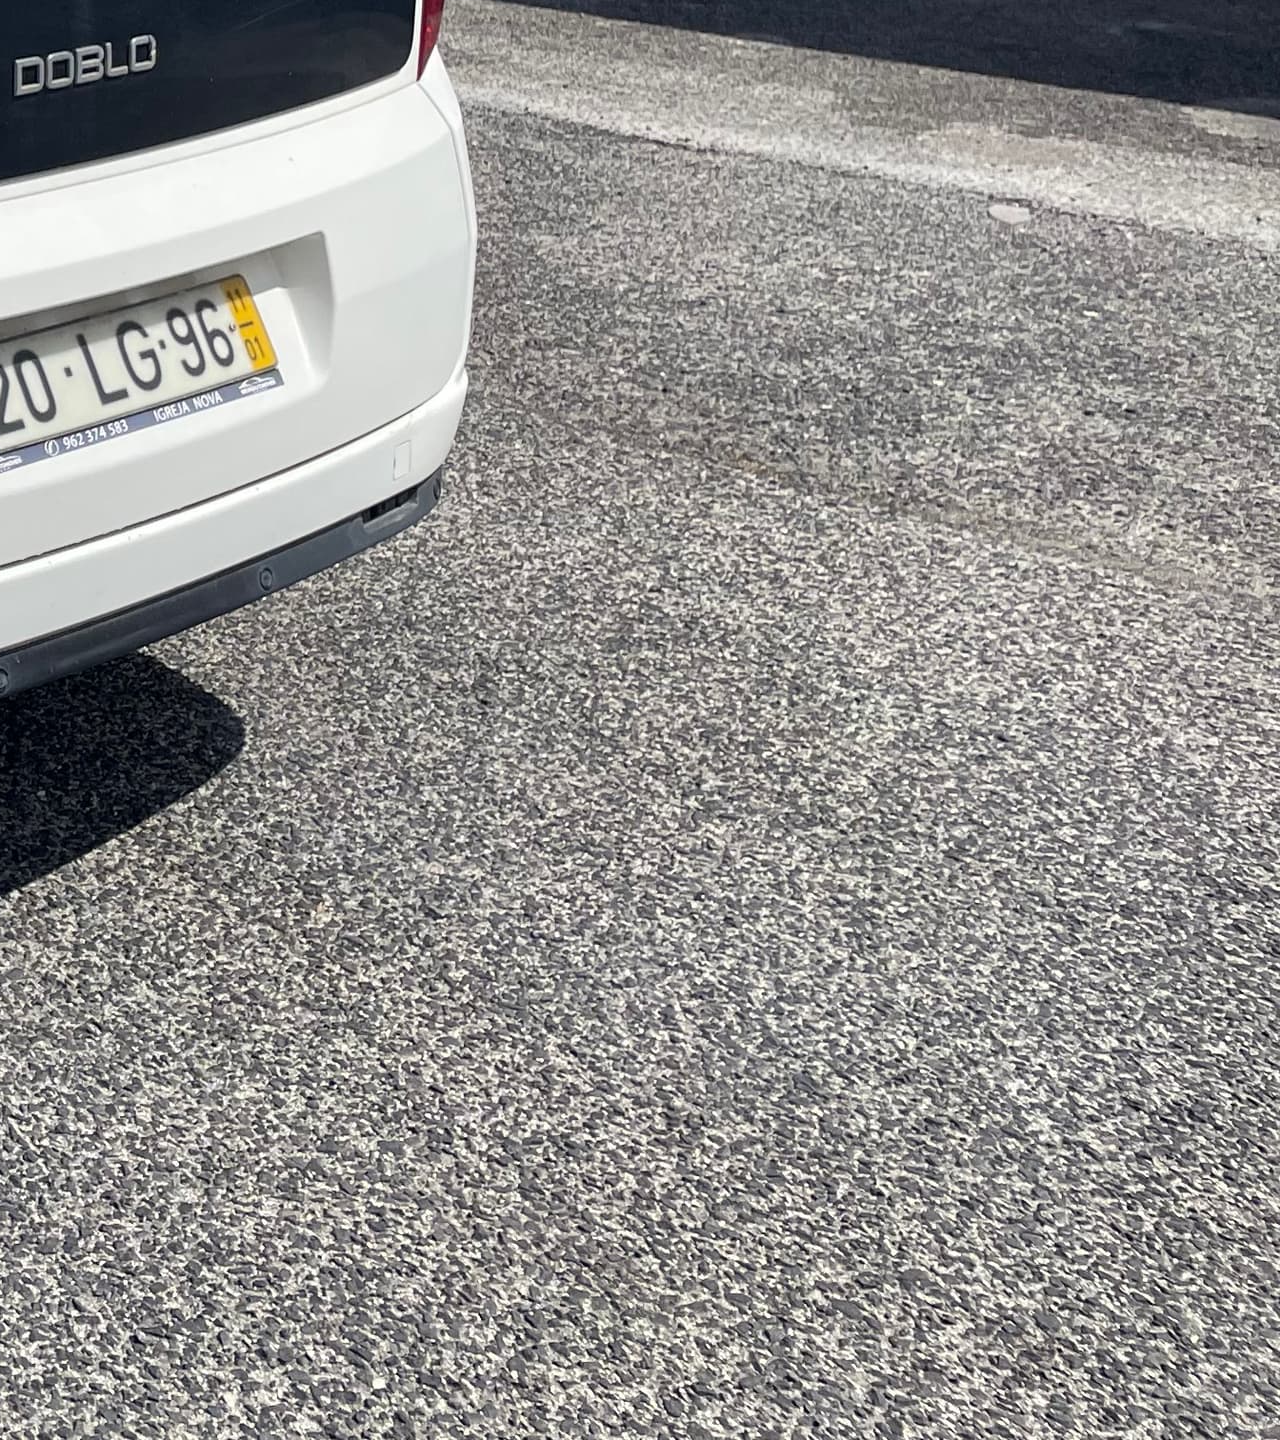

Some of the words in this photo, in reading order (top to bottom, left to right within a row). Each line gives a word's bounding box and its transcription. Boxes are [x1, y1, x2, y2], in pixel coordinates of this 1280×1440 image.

[13, 34, 157, 97] DOBLO
[226, 288, 246, 313] 11
[244, 336, 266, 361] 01
[62, 435, 85, 450] 962
[87, 427, 107, 442] 374
[108, 419, 129, 435] 583
[153, 399, 191, 422] IGREJA
[192, 391, 224, 409] NOVA
